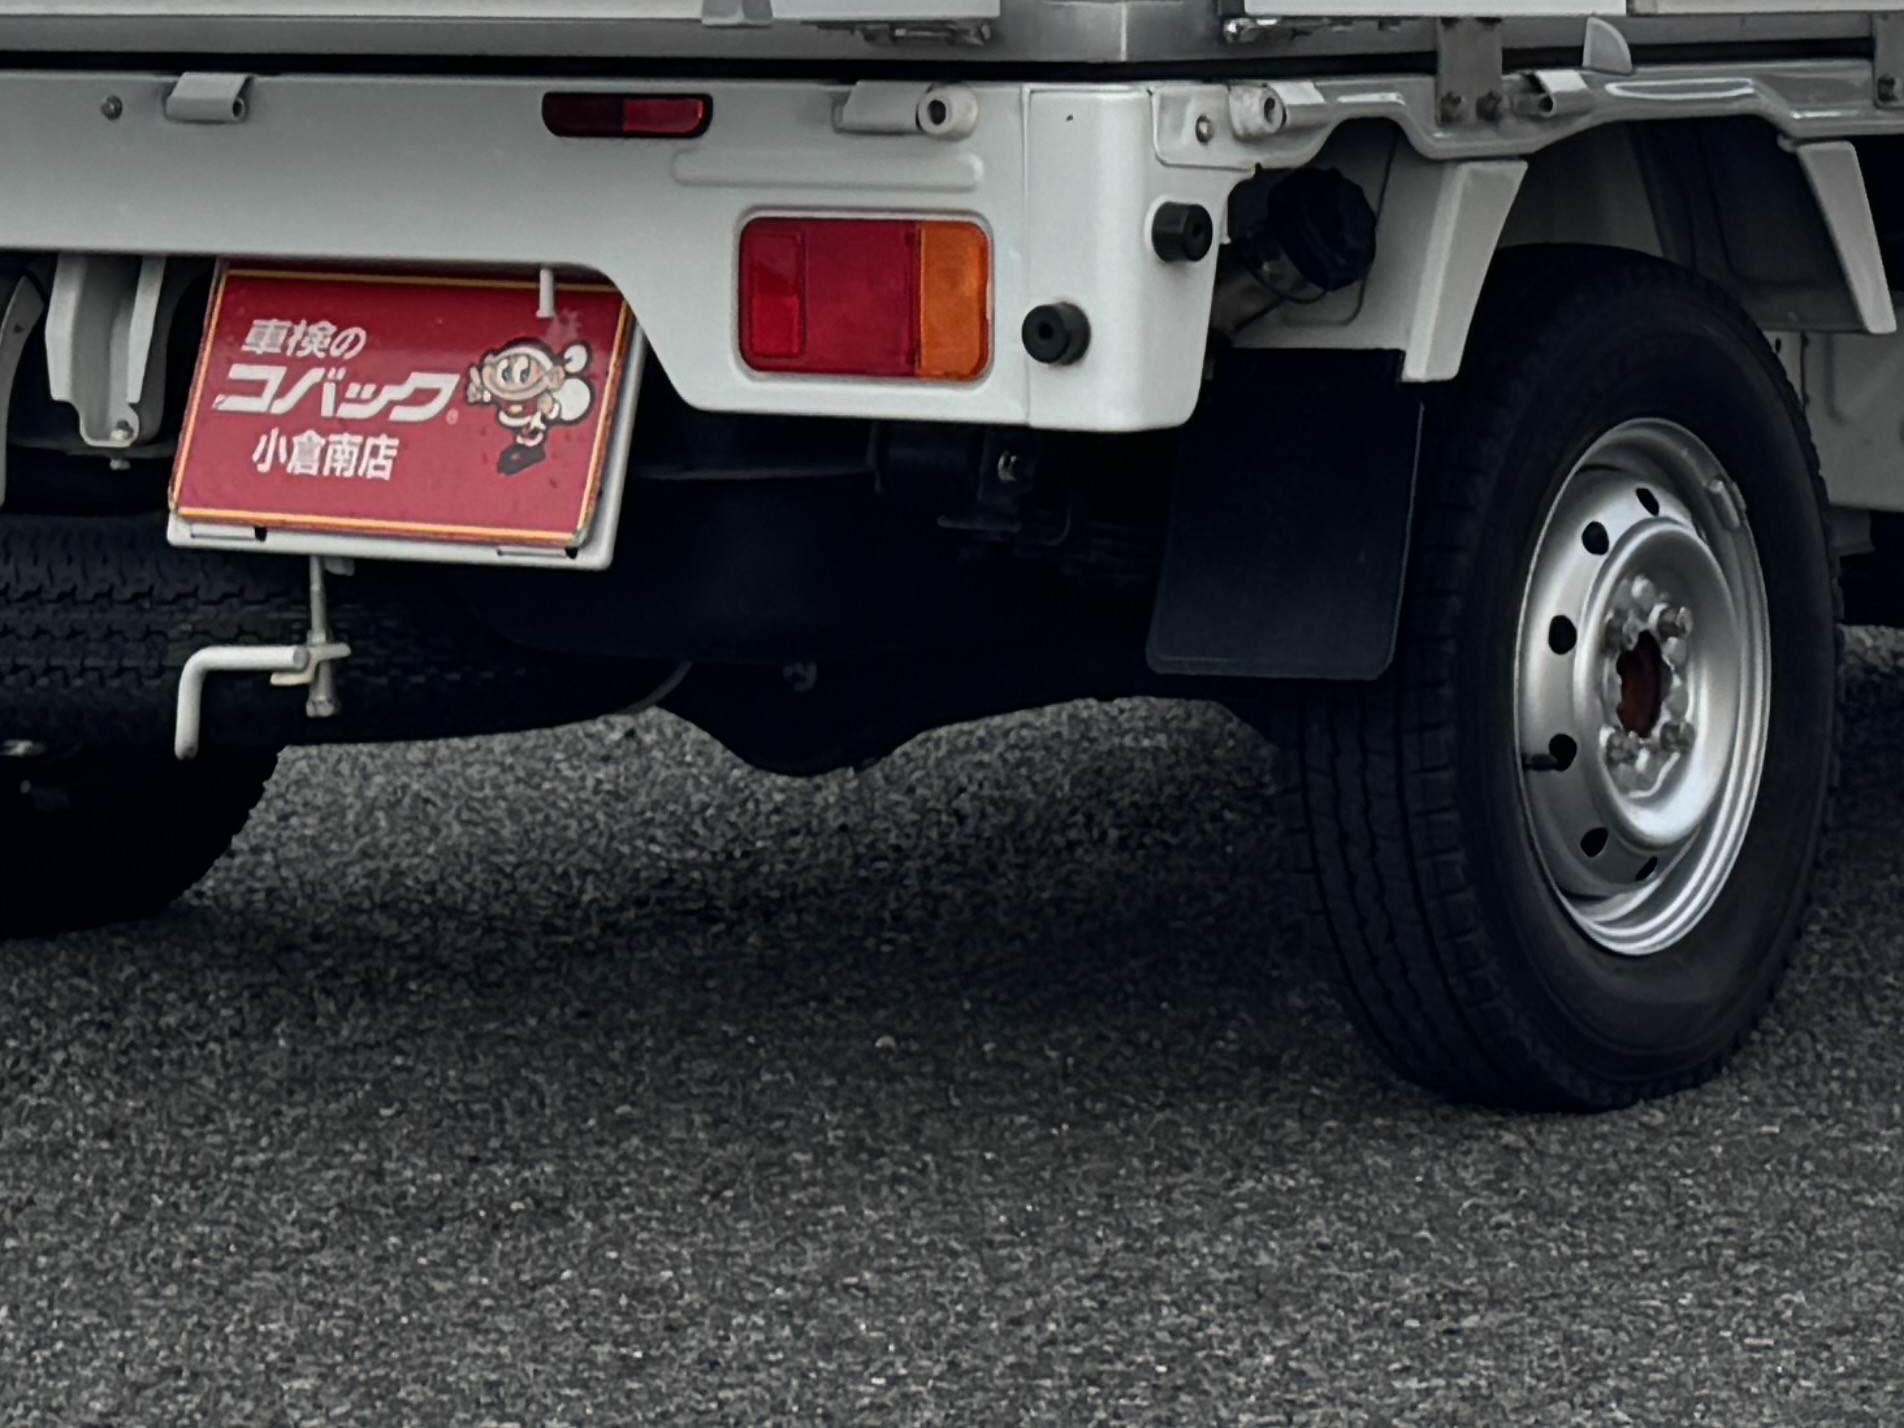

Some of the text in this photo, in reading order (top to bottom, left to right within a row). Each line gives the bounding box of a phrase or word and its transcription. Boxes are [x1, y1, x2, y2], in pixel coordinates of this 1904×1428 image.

[241, 319, 367, 360] 車検の
[213, 363, 460, 423] コバック
[252, 428, 399, 480] 小倉南店
